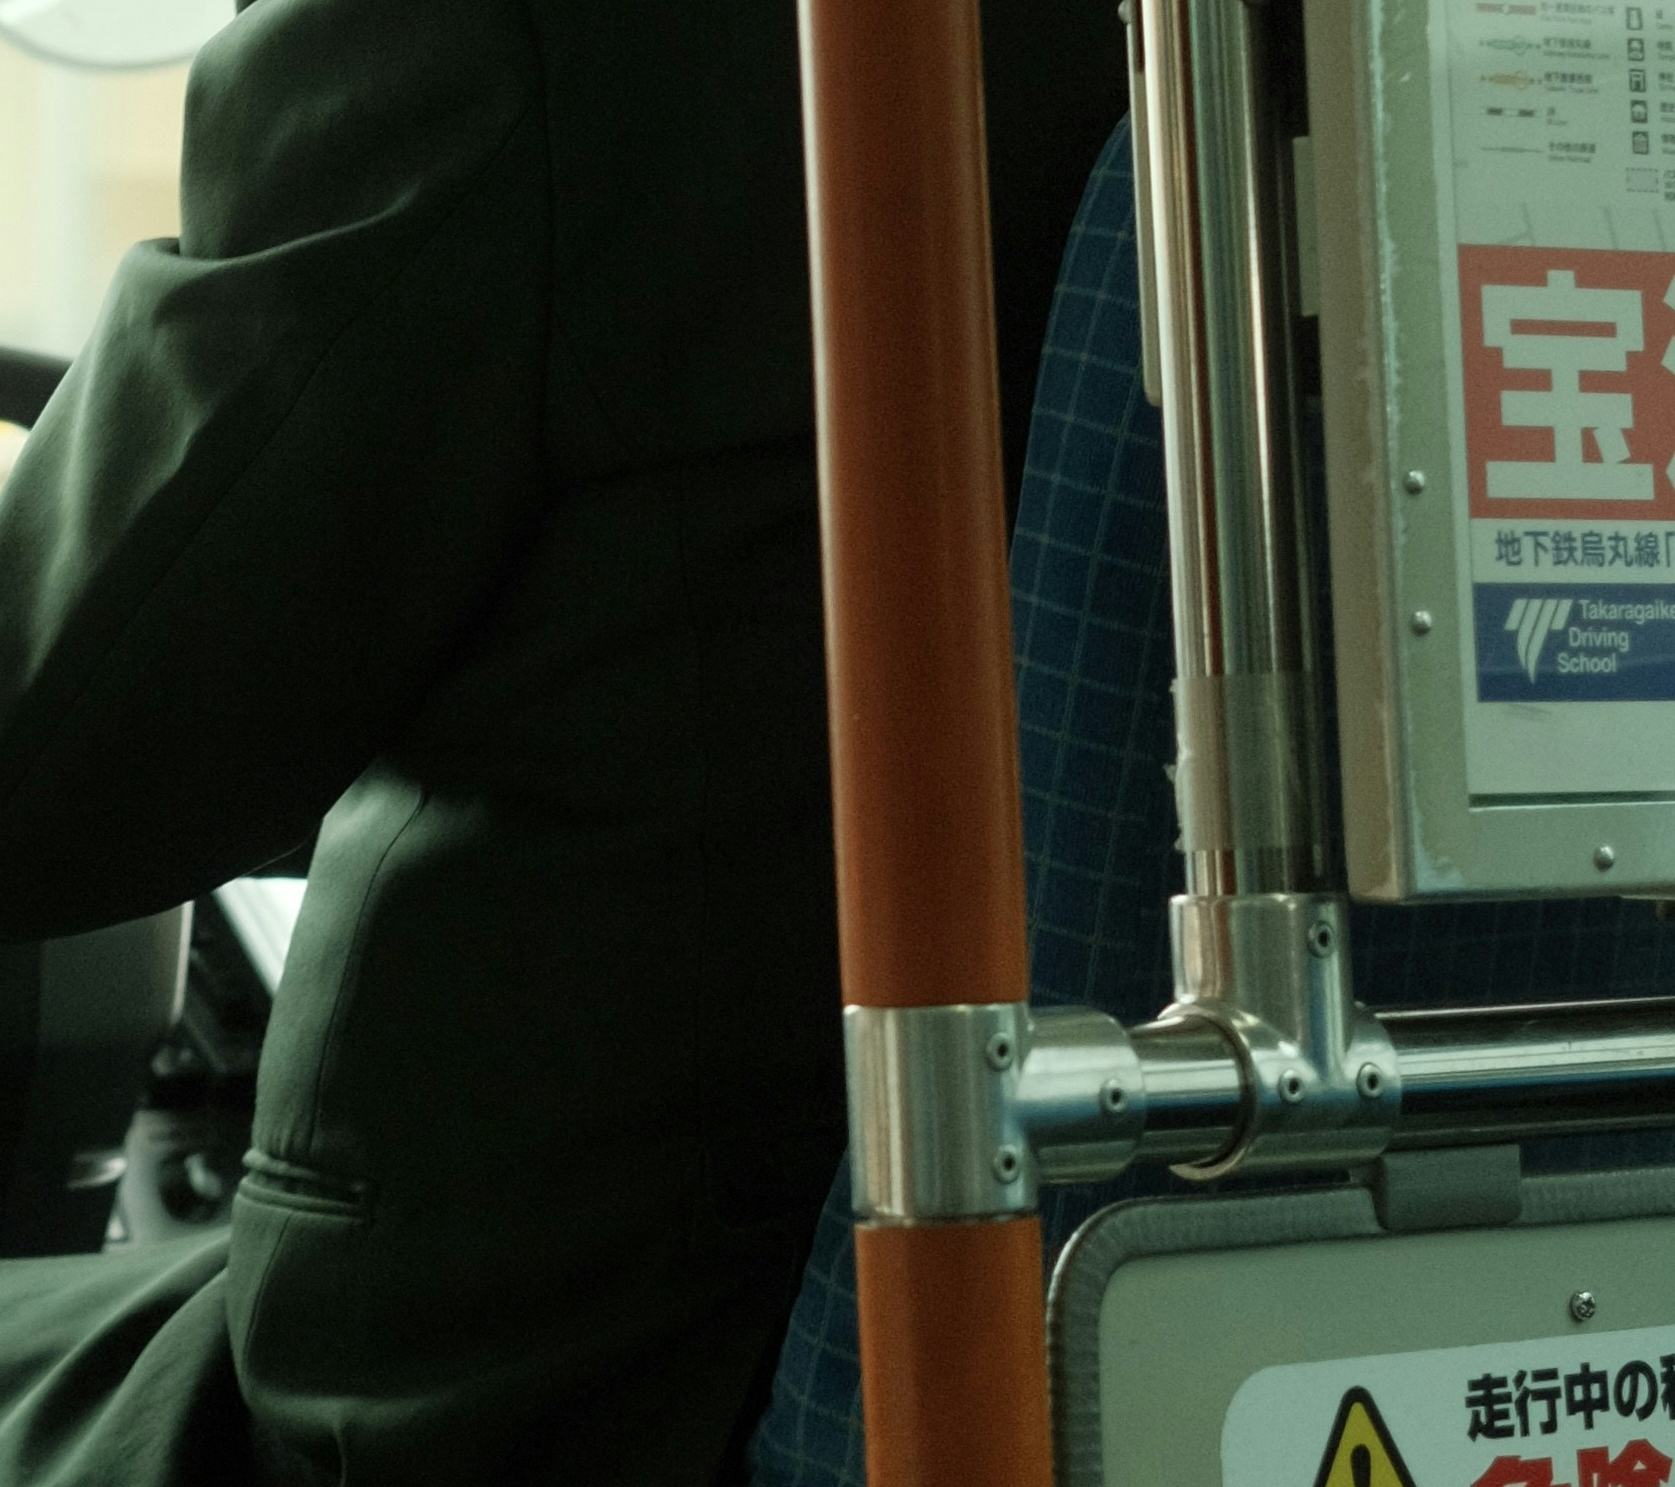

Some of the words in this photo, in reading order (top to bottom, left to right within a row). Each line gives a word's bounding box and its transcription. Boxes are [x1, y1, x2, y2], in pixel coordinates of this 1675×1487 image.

[1480, 268, 1675, 501] 宝
[1579, 598, 1675, 625] Takaragaike
[1568, 626, 1630, 654] Driving
[1556, 652, 1617, 673] School
